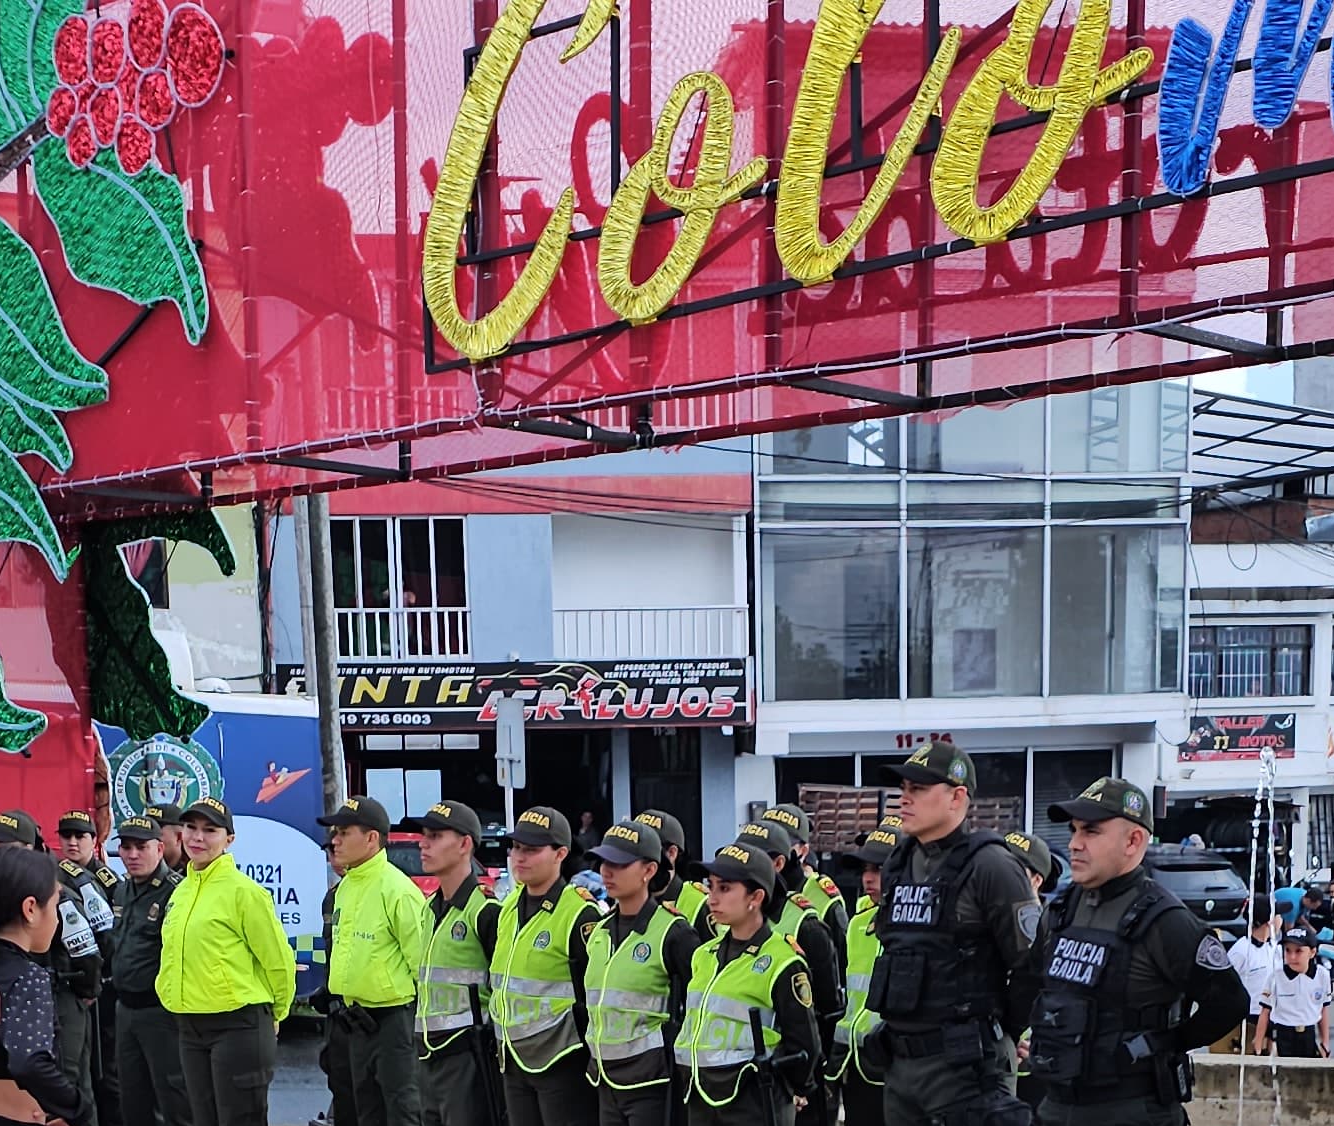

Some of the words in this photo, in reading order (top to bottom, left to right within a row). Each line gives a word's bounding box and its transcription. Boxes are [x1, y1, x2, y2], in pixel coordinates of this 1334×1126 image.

[361, 713, 391, 725] 736
[392, 713, 432, 725] 6003
[1214, 716, 1266, 730] TALLER
[1238, 734, 1286, 749] MOTOS
[178, 750, 209, 797] COLOMBIA
[891, 903, 932, 923] GAULA
[1053, 937, 1106, 966] POLICIA
[1048, 959, 1095, 985] GAULA
